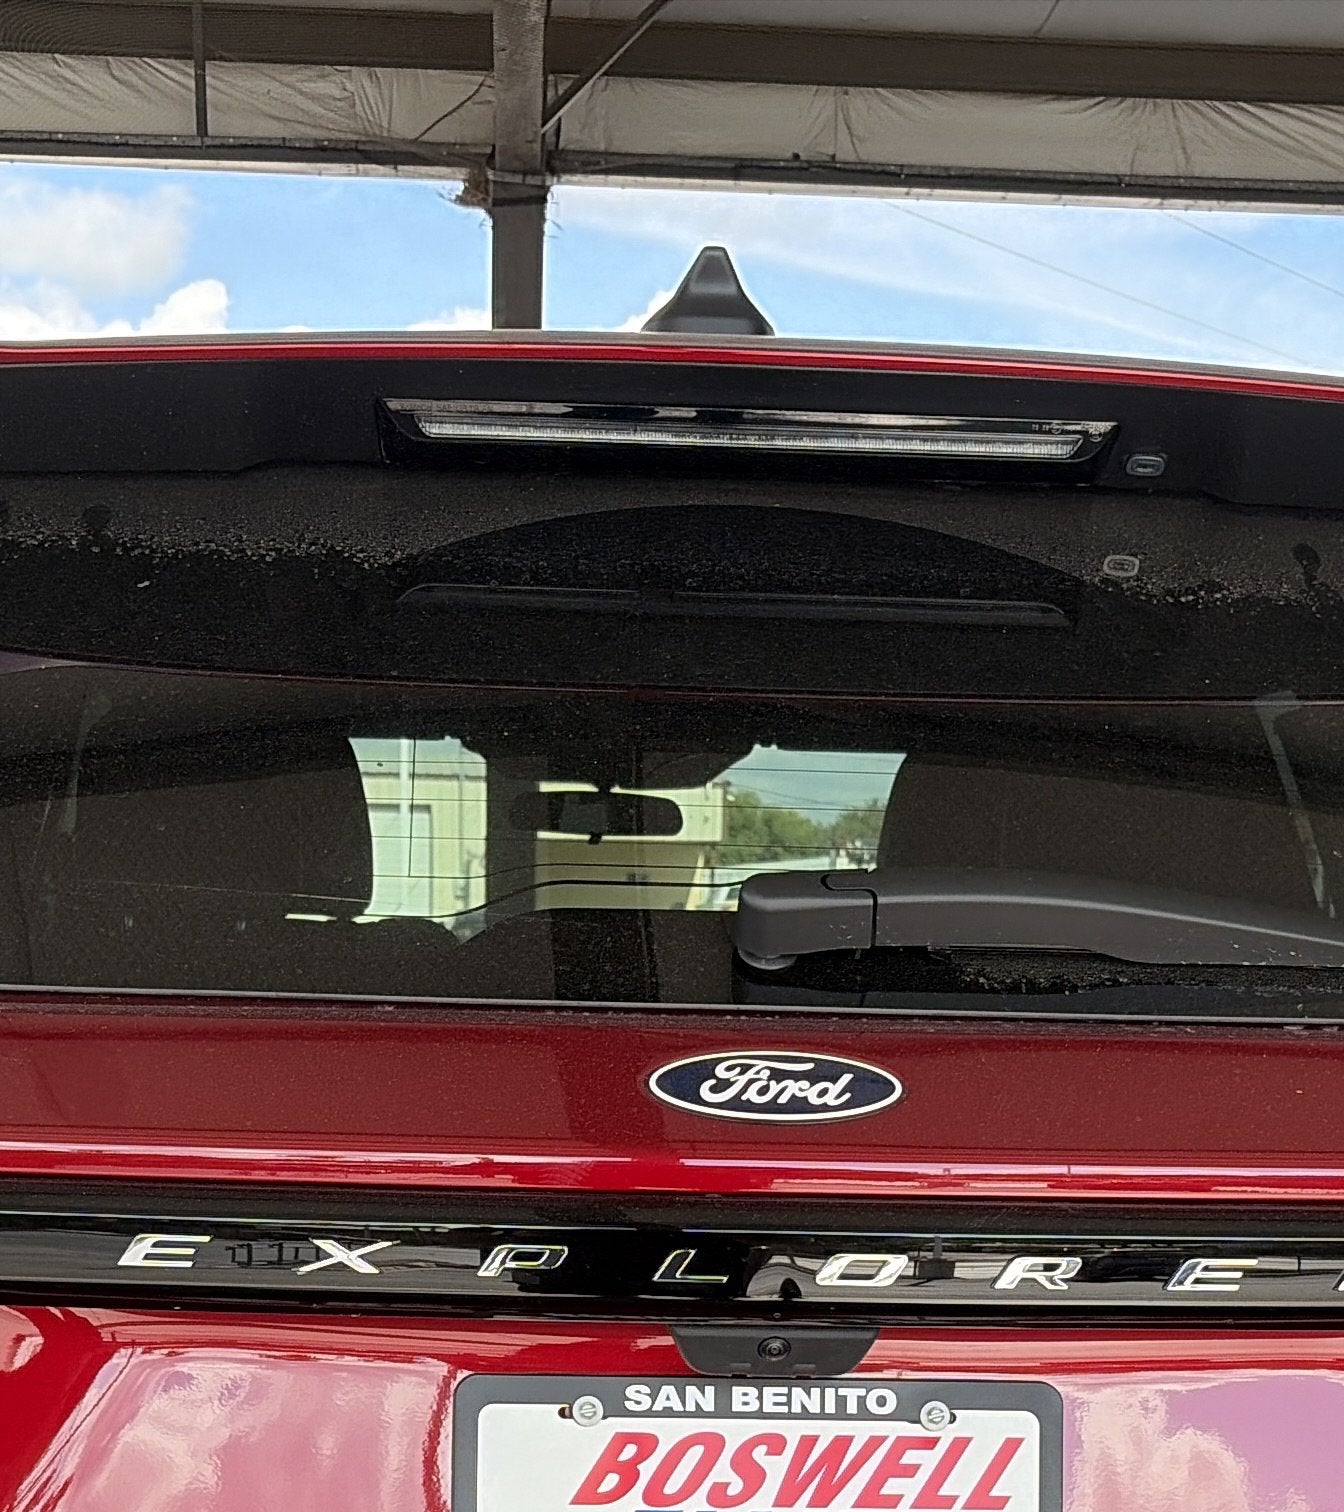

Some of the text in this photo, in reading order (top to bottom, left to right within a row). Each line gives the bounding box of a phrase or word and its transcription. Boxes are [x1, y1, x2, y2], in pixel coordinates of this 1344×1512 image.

[699, 1059, 854, 1106] Ford
[624, 1385, 897, 1414] SAN BENITO
[569, 1432, 1024, 1510] BOSWELL
